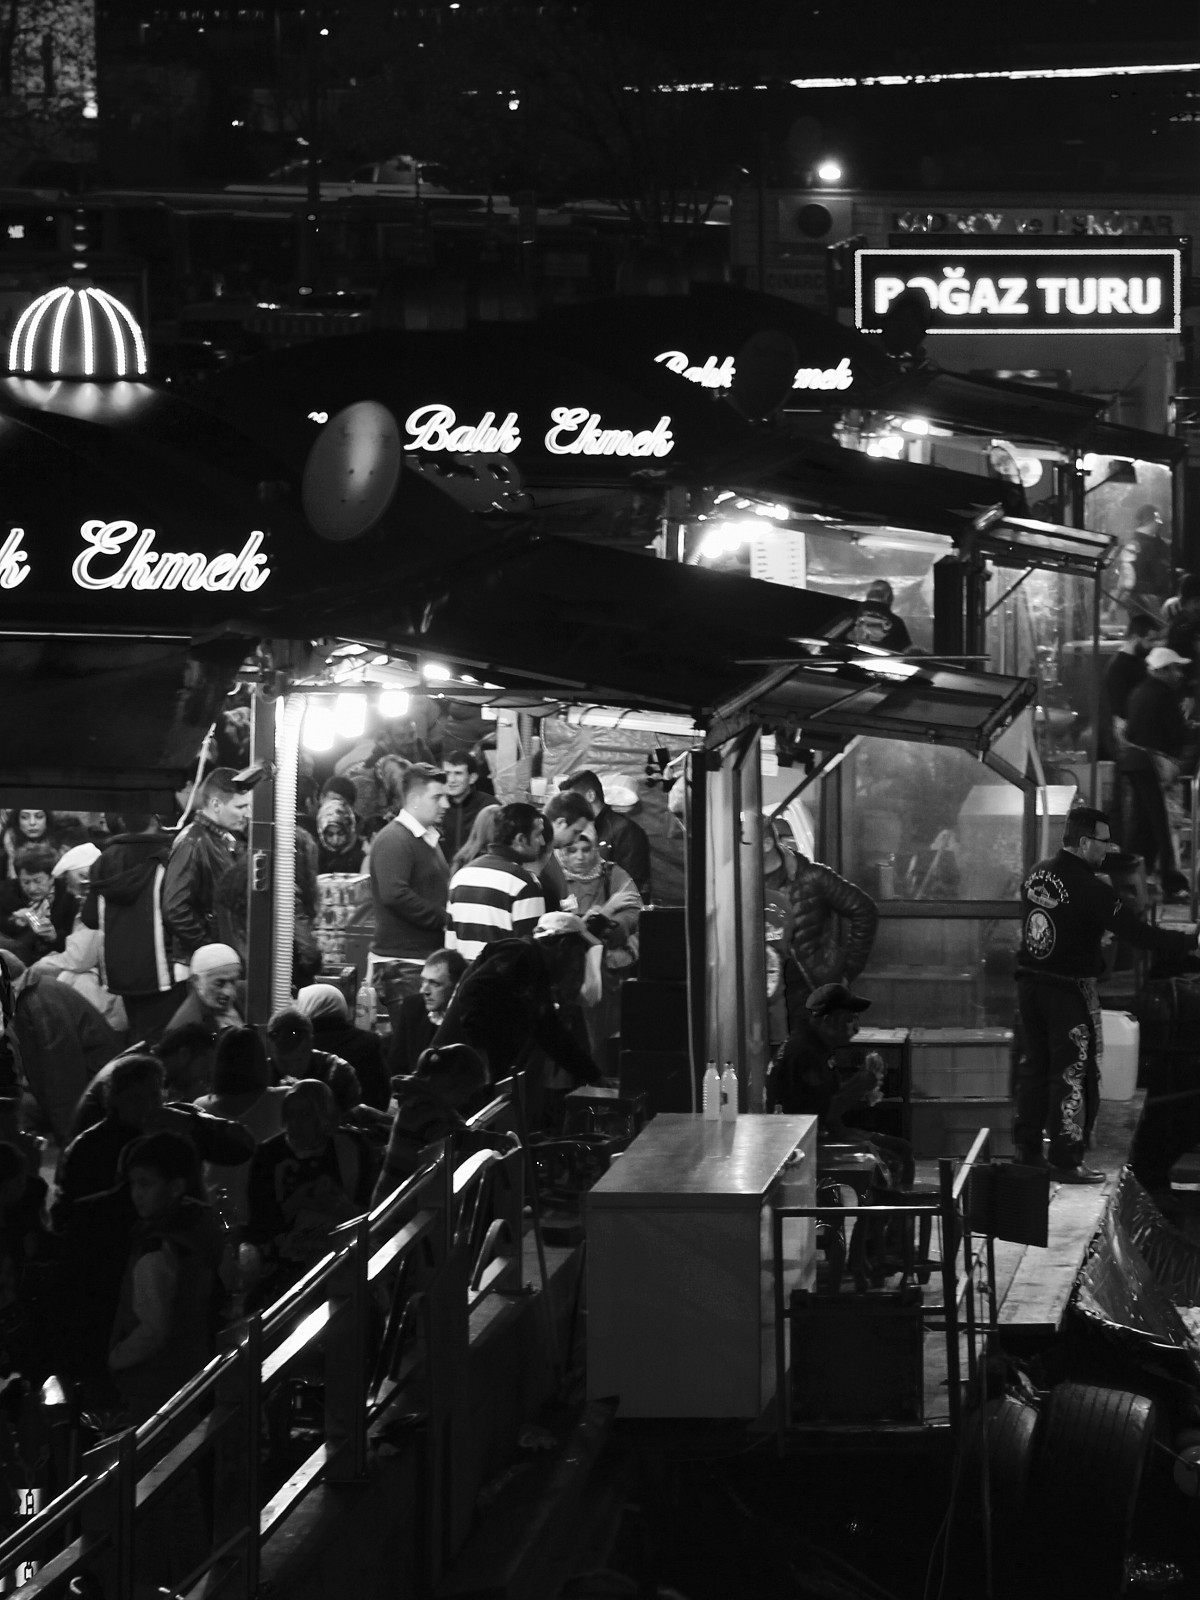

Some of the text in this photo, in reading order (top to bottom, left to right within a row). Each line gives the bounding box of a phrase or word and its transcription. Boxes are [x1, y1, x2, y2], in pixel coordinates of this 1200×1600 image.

[1035, 276, 1162, 315] TURU
[791, 357, 854, 391] mek
[403, 403, 675, 457] Balık Ekmek
[71, 519, 271, 592] Ekmek
